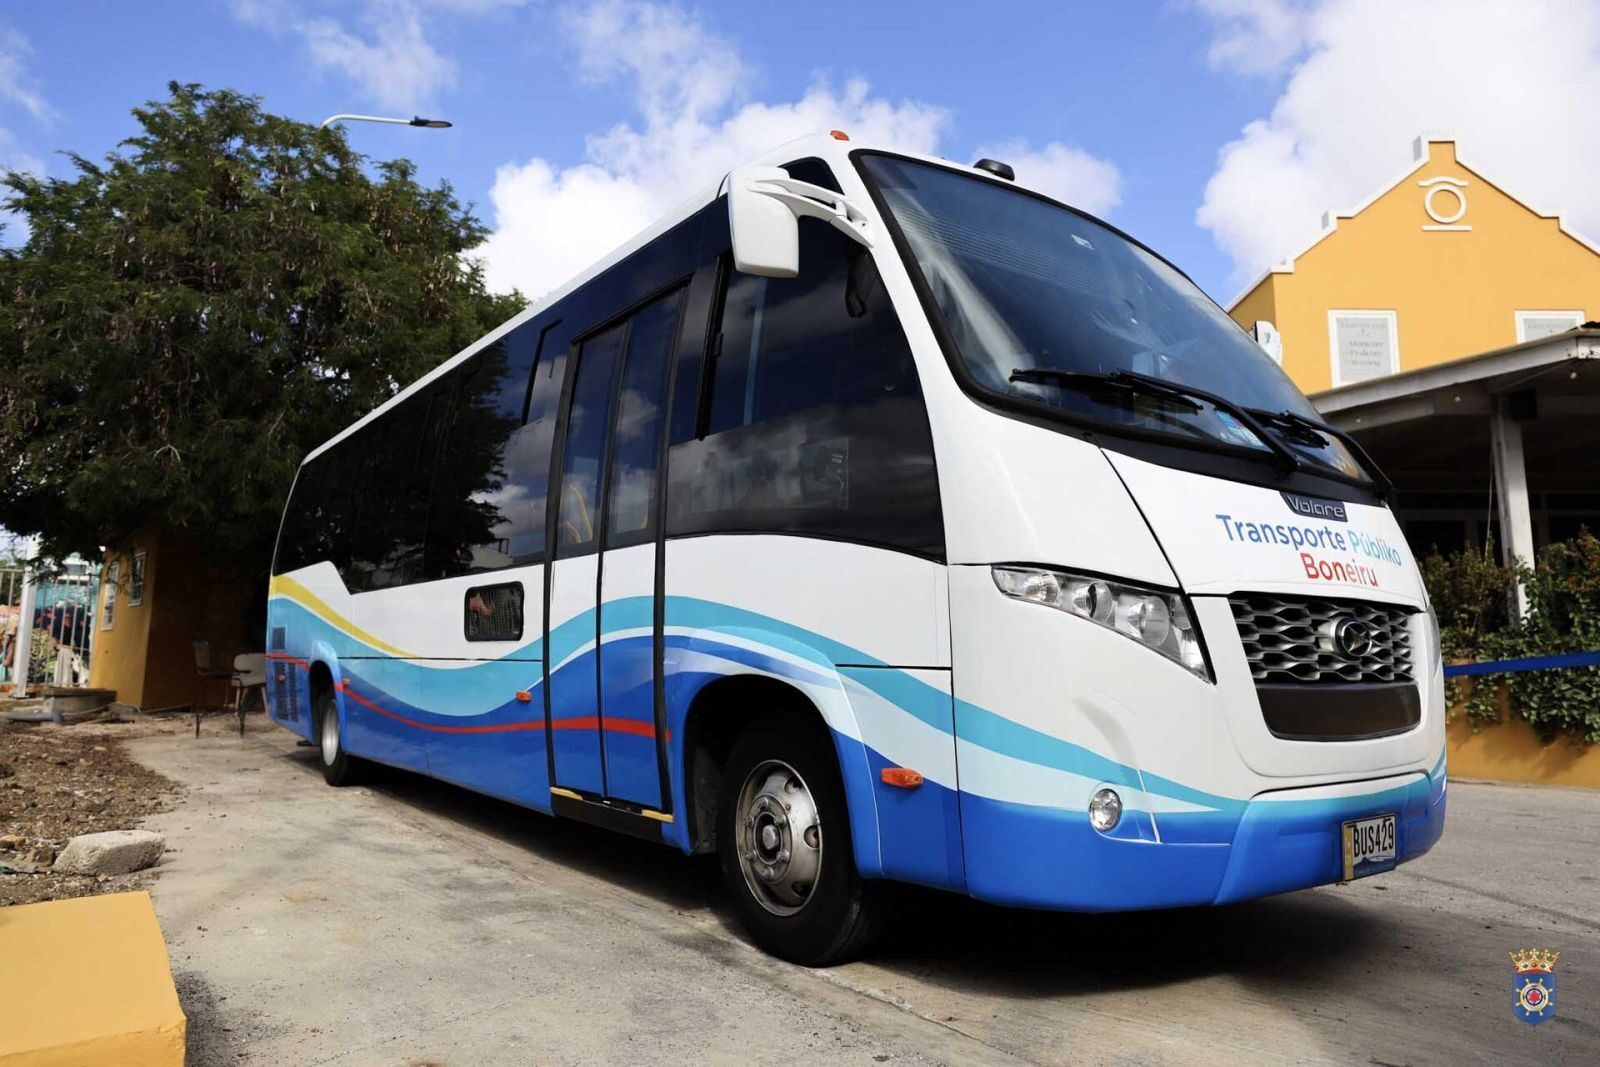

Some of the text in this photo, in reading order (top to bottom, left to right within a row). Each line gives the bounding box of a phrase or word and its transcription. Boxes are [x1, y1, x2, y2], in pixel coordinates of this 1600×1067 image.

[1287, 495, 1345, 518] Volare
[1215, 514, 1402, 567] Transporte Públiko
[1300, 552, 1379, 587] Boneiru
[1353, 821, 1394, 858] BUS429
